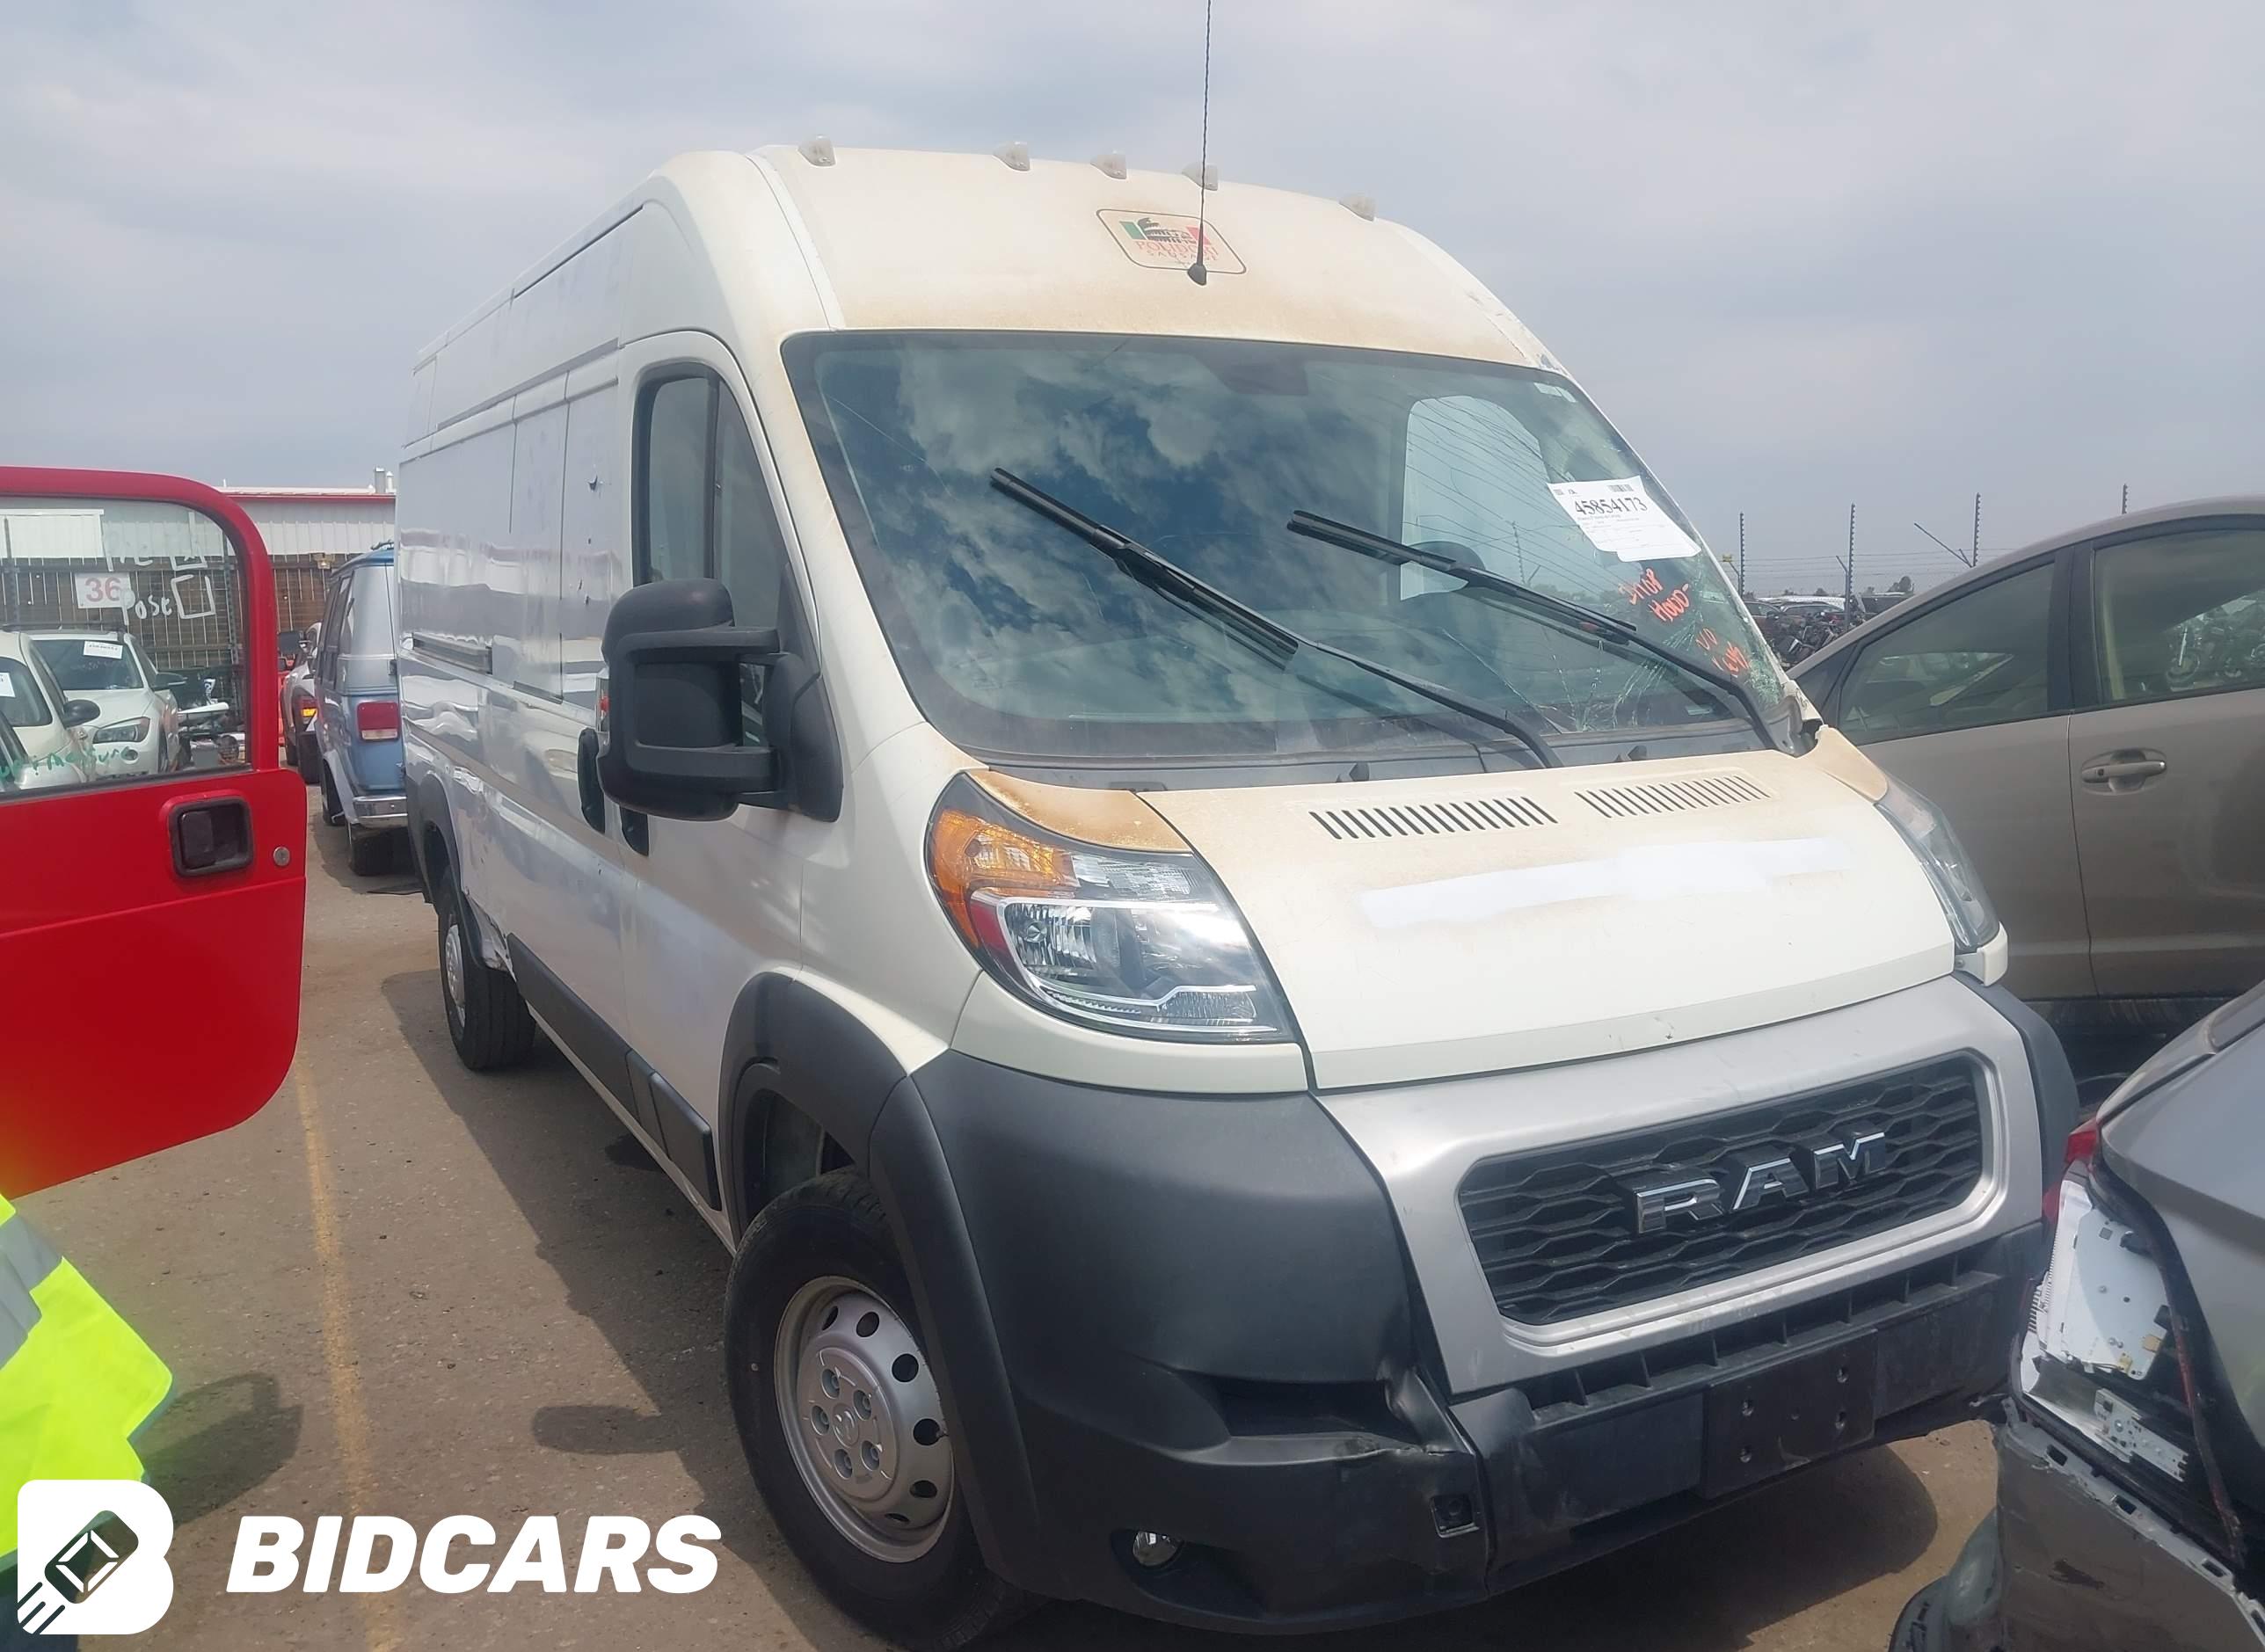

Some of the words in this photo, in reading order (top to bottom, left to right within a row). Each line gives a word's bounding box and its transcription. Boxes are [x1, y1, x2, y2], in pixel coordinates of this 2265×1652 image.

[1574, 497, 1649, 515] 45854173
[84, 578, 121, 602] 36
[1634, 1131, 1886, 1235] RAM
